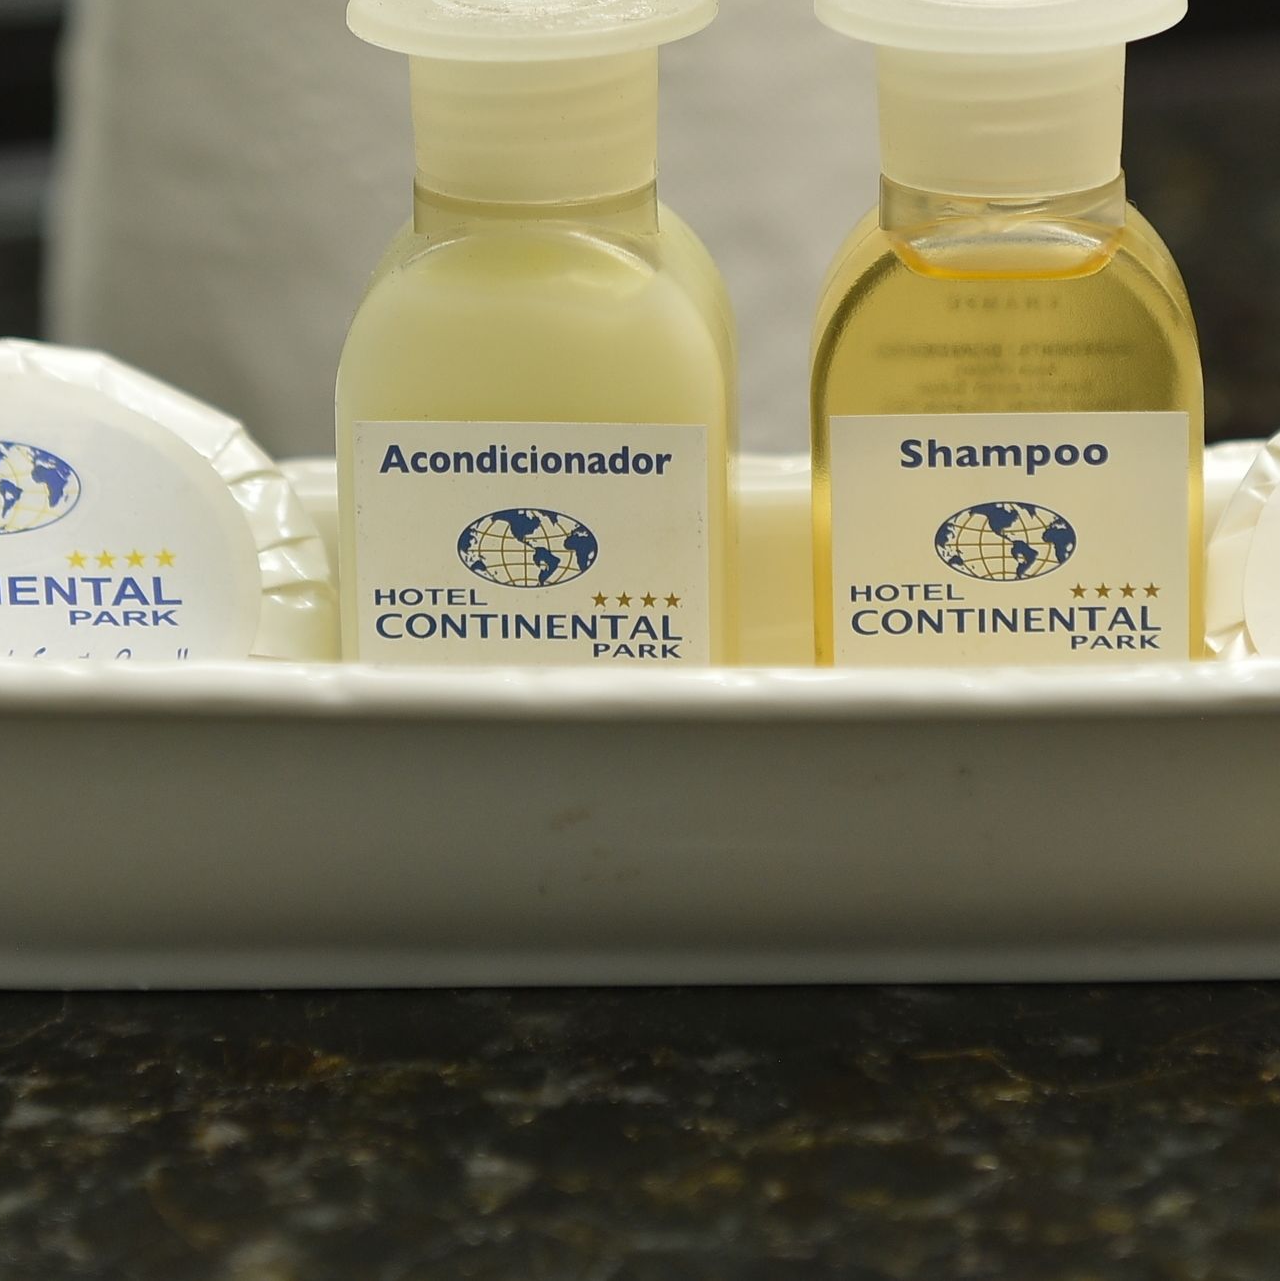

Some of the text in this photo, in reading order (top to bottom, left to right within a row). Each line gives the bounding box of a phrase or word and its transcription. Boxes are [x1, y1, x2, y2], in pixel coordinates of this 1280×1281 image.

[379, 444, 672, 475] Acondicionador
[900, 438, 1109, 476] Shampoo
[374, 588, 488, 606] HOTEL
[850, 583, 965, 603] HOTEL
[69, 609, 179, 627] PARK
[375, 613, 683, 641] CONTINENTAL
[851, 605, 1162, 636] CONTINENTAL
[593, 643, 682, 659] PARK
[1070, 634, 1161, 650] PARK
